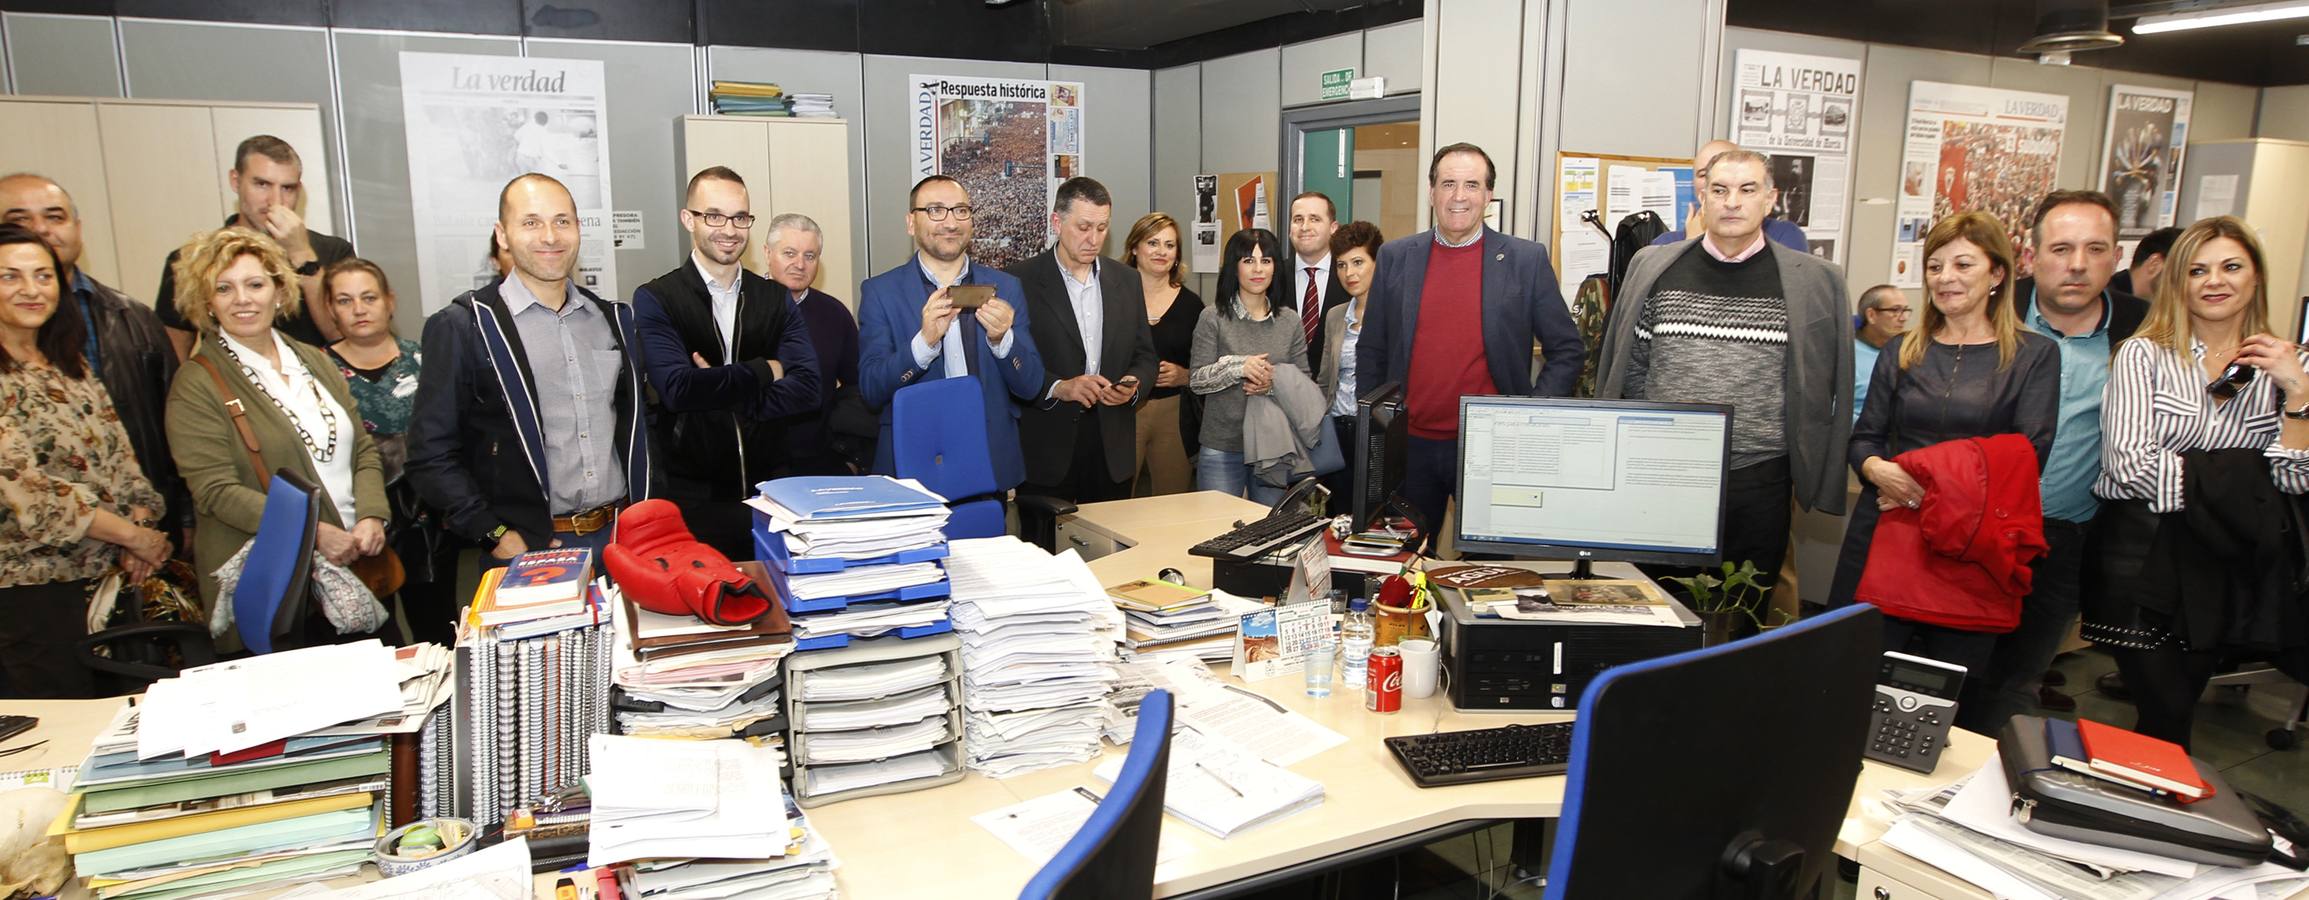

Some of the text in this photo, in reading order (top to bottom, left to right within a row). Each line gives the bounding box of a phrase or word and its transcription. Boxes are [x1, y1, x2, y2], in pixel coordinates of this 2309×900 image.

[451, 66, 566, 93] La verdad
[941, 80, 1046, 99] Respuesta histórica
[1323, 85, 1348, 97] EMERGENC
[1324, 74, 1340, 85] SALIDA
[1761, 65, 1783, 88] LA
[1791, 68, 1856, 94] VERDAD
[919, 91, 933, 163] VERDAD
[1383, 670, 1402, 693] Co
